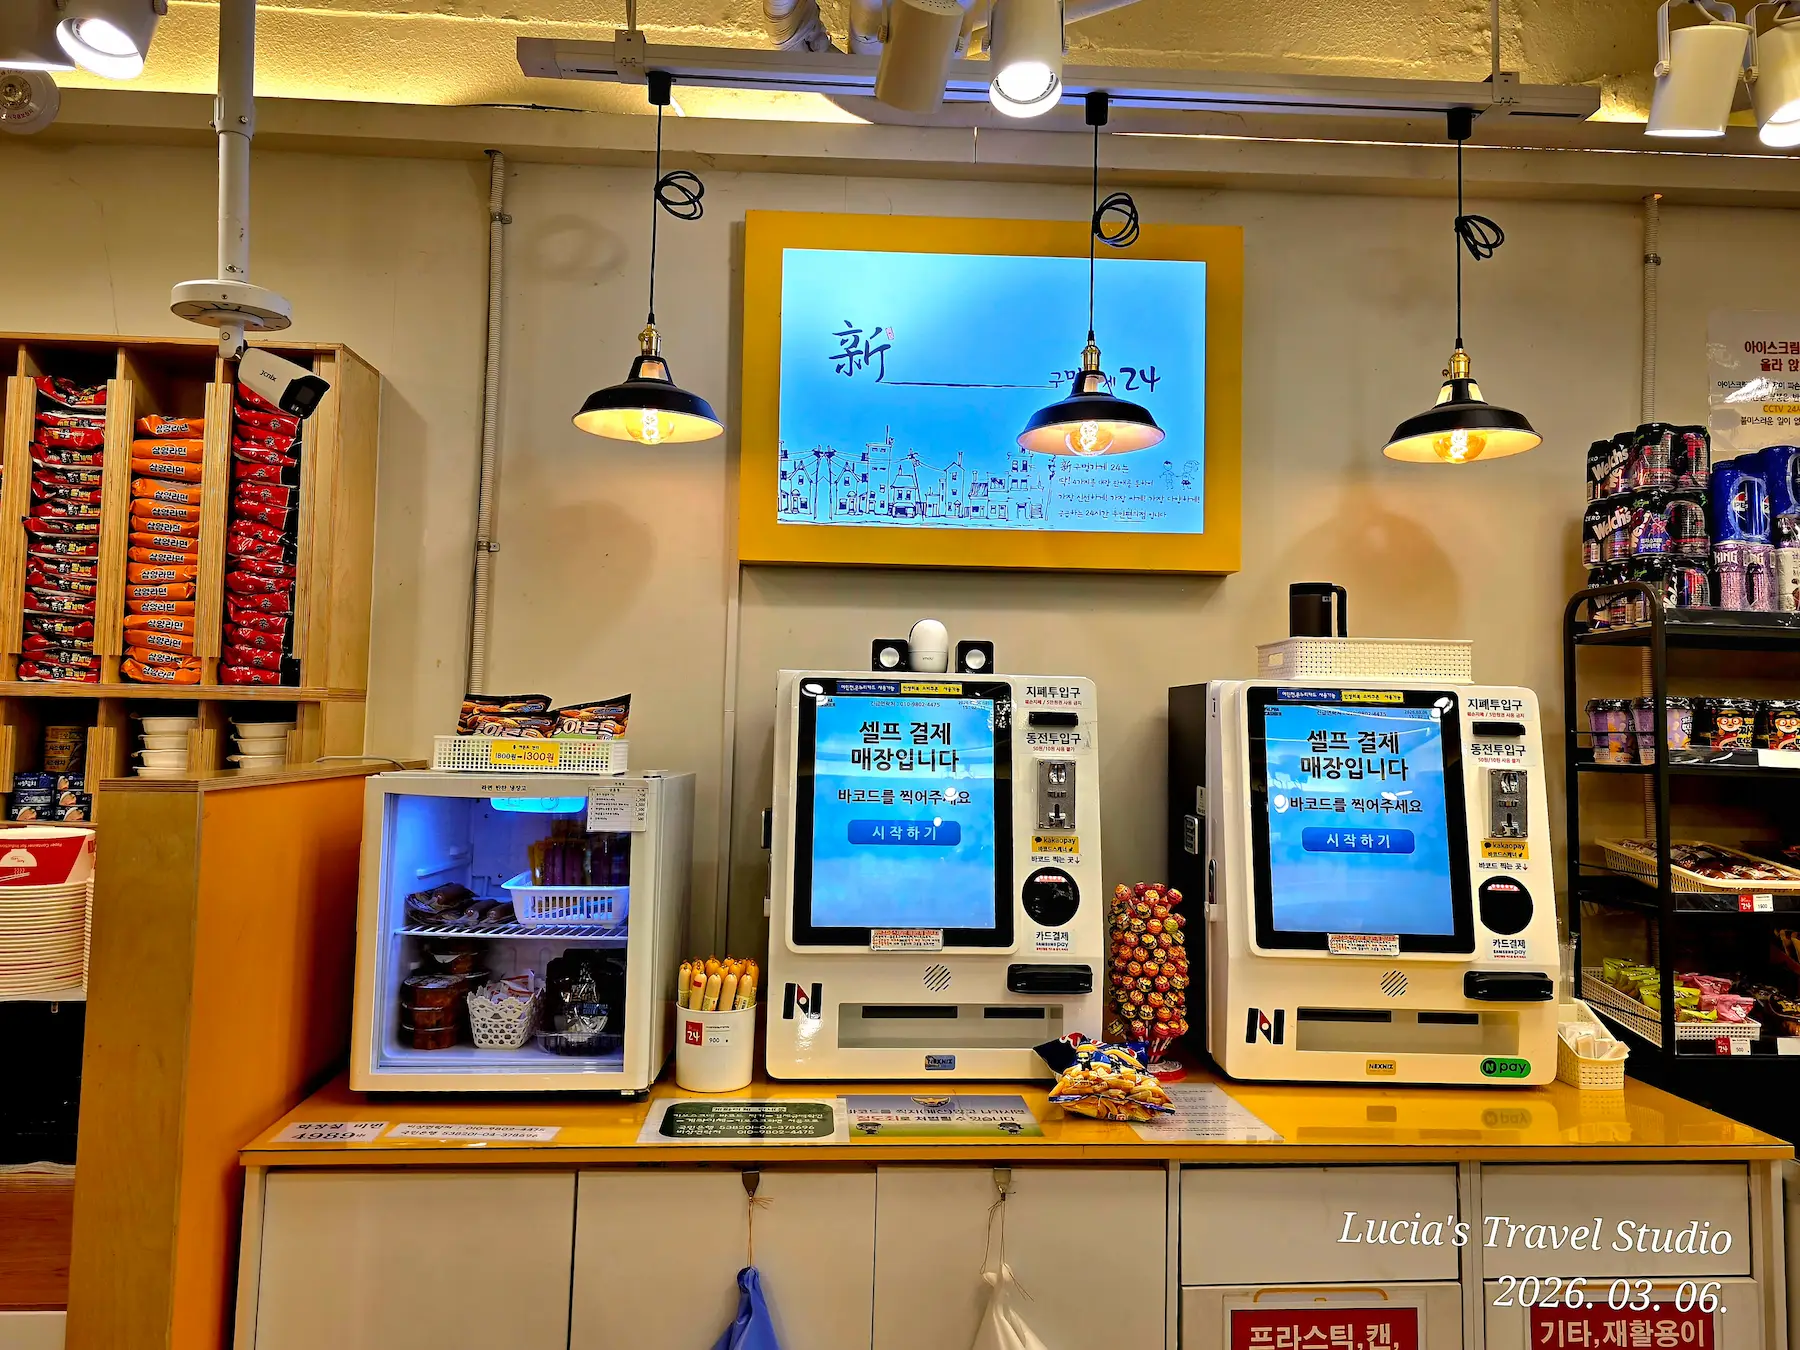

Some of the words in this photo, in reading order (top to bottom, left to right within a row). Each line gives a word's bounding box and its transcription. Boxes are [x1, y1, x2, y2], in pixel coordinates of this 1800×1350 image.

[829, 319, 891, 383] 新
[1119, 365, 1160, 392] 24
[1763, 405, 1784, 413] CCTV
[152, 446, 187, 456] 삼양라면
[149, 463, 184, 475] 삼양라면
[155, 491, 188, 500] 삼양라면
[152, 507, 187, 518] 삼양라면
[147, 522, 181, 533] 삼양라면
[1592, 507, 1632, 540] Welch's
[154, 538, 188, 548] 삼양라면
[149, 553, 184, 562] 삼양라면
[1714, 552, 1738, 564] KING
[141, 570, 175, 580] 삼양라면
[133, 587, 168, 596] 삼양라면
[141, 602, 175, 612] 삼양라면
[148, 620, 184, 631] 삼양라면
[147, 635, 182, 648] 삼양라면
[1026, 686, 1081, 699] 지폐투입구
[1468, 698, 1523, 711] 지폐투입구
[859, 721, 902, 744] 셀프
[910, 722, 951, 745] 결제
[1026, 733, 1082, 745] 동전투입구
[1307, 730, 1349, 753] 셀프
[1357, 731, 1399, 755] 결제
[1470, 743, 1526, 756] 동전투입구
[495, 752, 516, 761] 1800원
[524, 752, 554, 763] 1300원
[851, 748, 960, 772] 매장입니다
[1300, 757, 1408, 781] 매장입니다
[838, 789, 895, 804] 바코드를
[1290, 797, 1347, 812] 바코드를
[1352, 798, 1423, 814] 찍어주세요
[1043, 837, 1076, 845] kakaopay
[1493, 842, 1526, 851] kakaopay
[1068, 856, 1074, 864] 곳
[1741, 902, 1752, 910] 24
[1036, 931, 1069, 941] 카드결제
[1492, 939, 1526, 949] 카드결제
[687, 1031, 700, 1042] 24
[1500, 1062, 1527, 1074] pay
[1248, 1323, 1399, 1350] 프라스틱,캔,
[1540, 1319, 1705, 1348] 기타,재활용이
